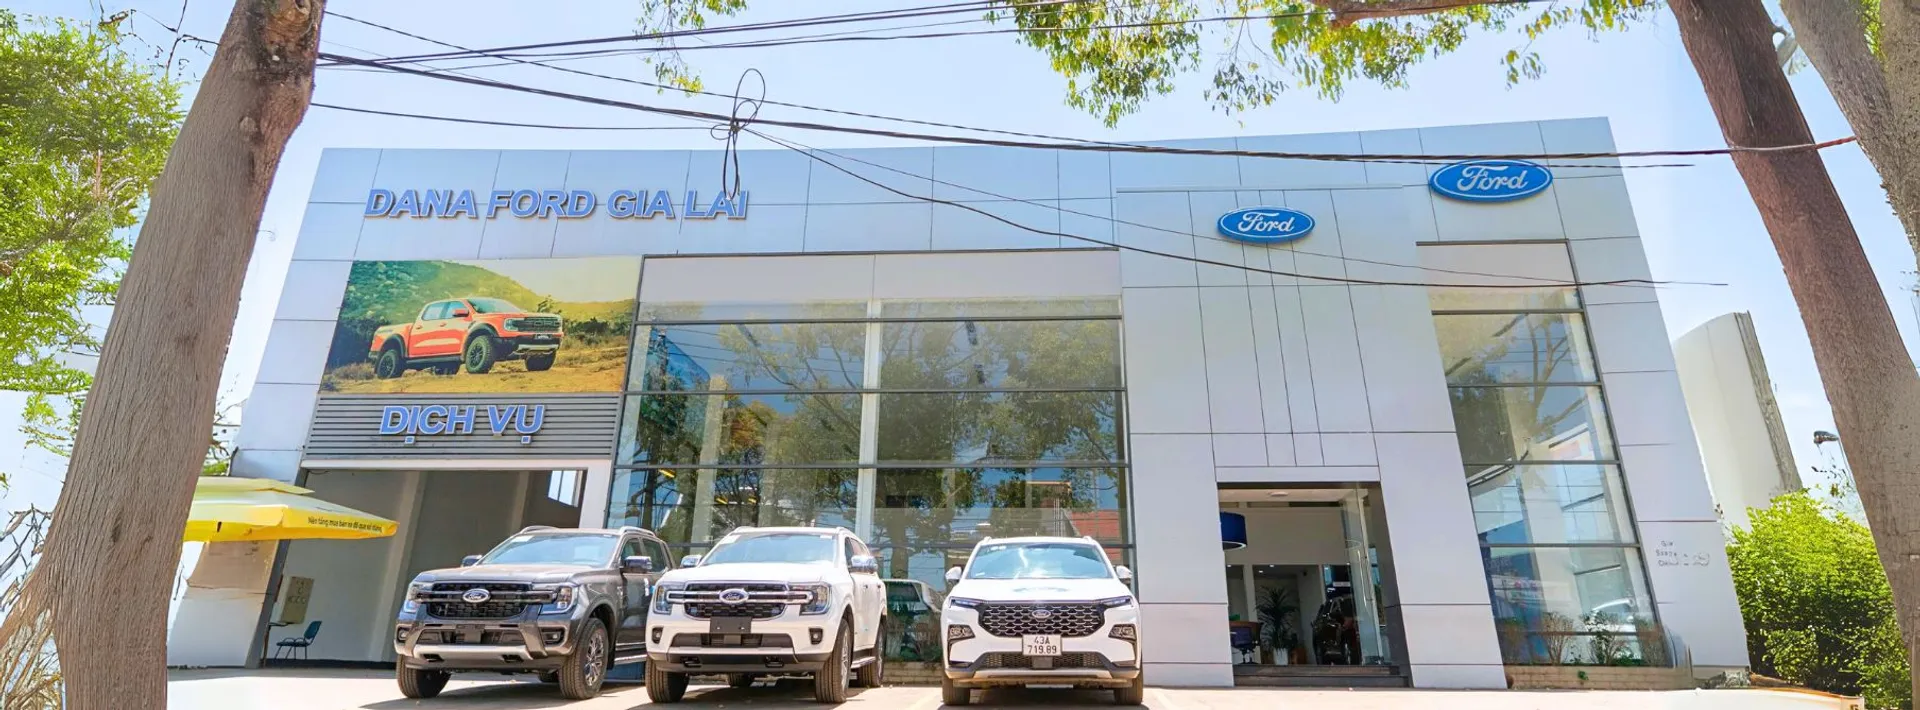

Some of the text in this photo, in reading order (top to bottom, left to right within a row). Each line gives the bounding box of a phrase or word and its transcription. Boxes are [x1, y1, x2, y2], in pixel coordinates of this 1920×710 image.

[364, 188, 749, 220] DANA FORD GIA LAI
[379, 405, 545, 444] DỊCH VỤ
[1027, 645, 1057, 654] 719.89
[1034, 636, 1050, 644] 43A
